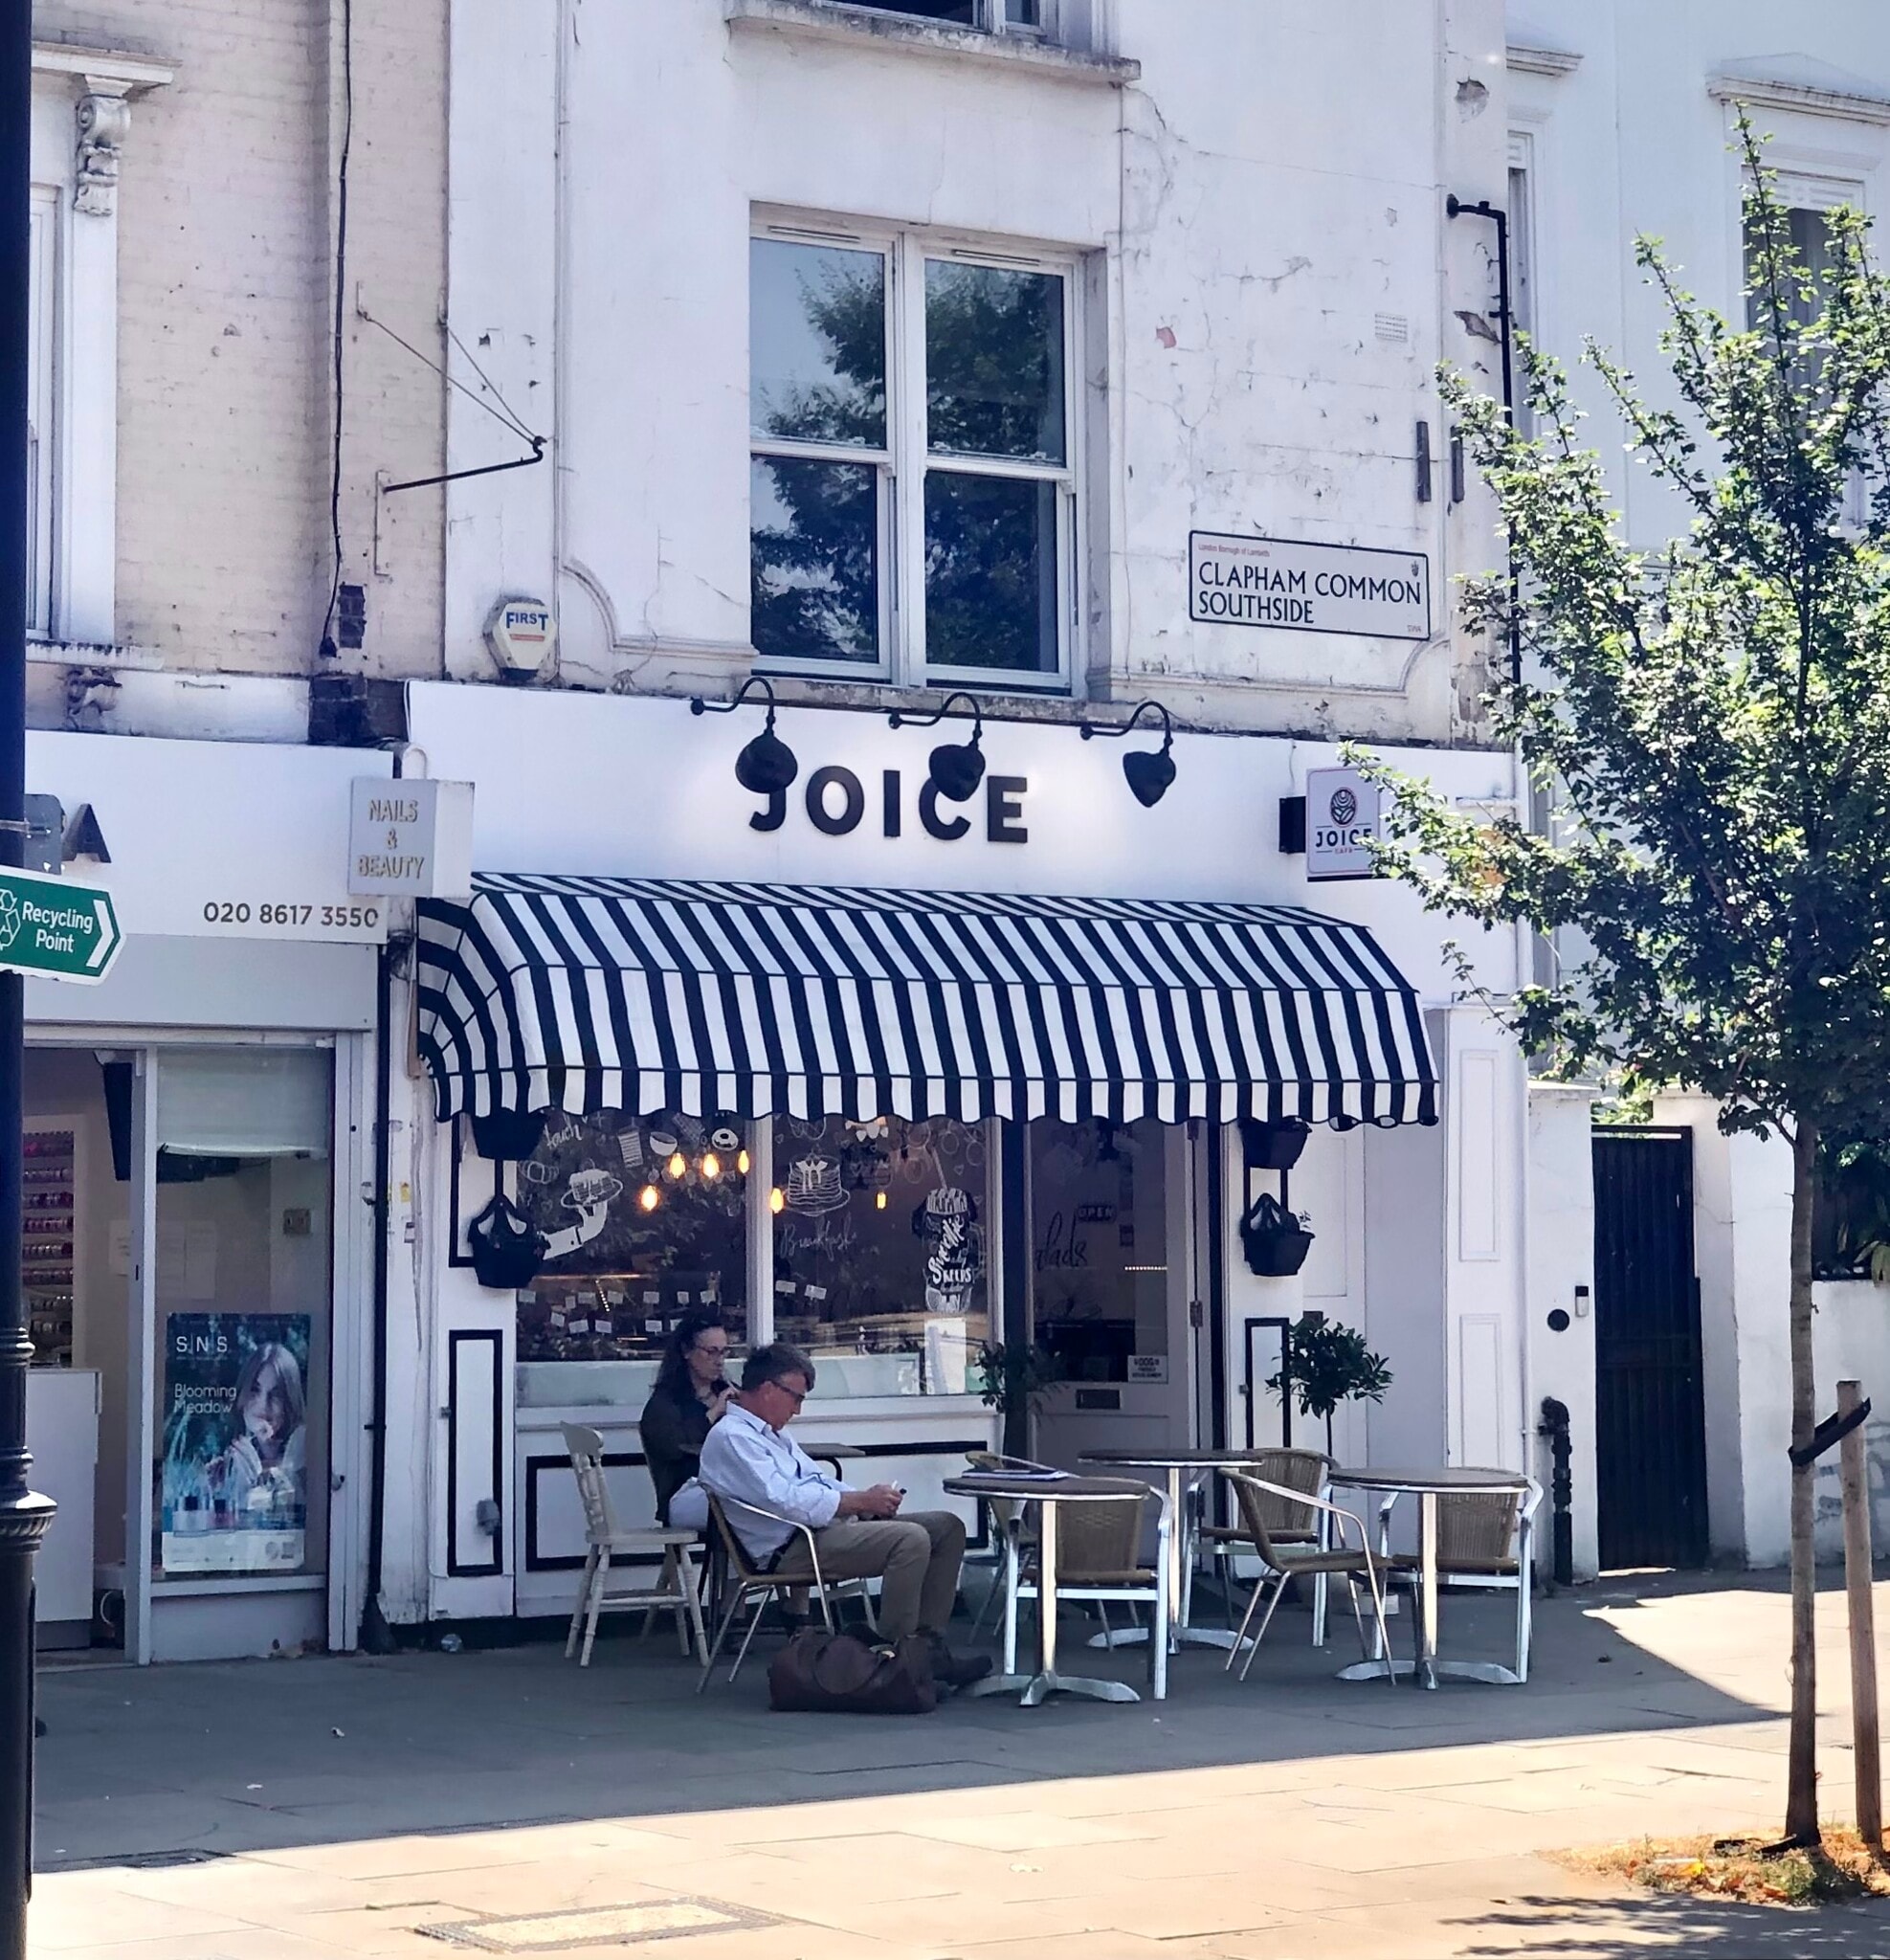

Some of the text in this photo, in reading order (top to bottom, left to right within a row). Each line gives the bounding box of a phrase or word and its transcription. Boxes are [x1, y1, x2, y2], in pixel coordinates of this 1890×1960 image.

[1199, 562, 1421, 604] CLAPHAM COMMON
[1199, 590, 1314, 623] SOUTHSIDE
[505, 612, 548, 631] FIRST
[369, 799, 418, 822] NAILS
[748, 765, 1028, 843] JOICE
[388, 828, 397, 850] &
[359, 855, 425, 880] BEAUTY
[22, 901, 94, 934] Recycling
[204, 902, 379, 928] 020 8617 3550
[35, 928, 75, 953] Point
[1078, 1207, 1114, 1217] OPEN
[174, 1383, 237, 1400] Blooming
[174, 1400, 233, 1414] Meadow
